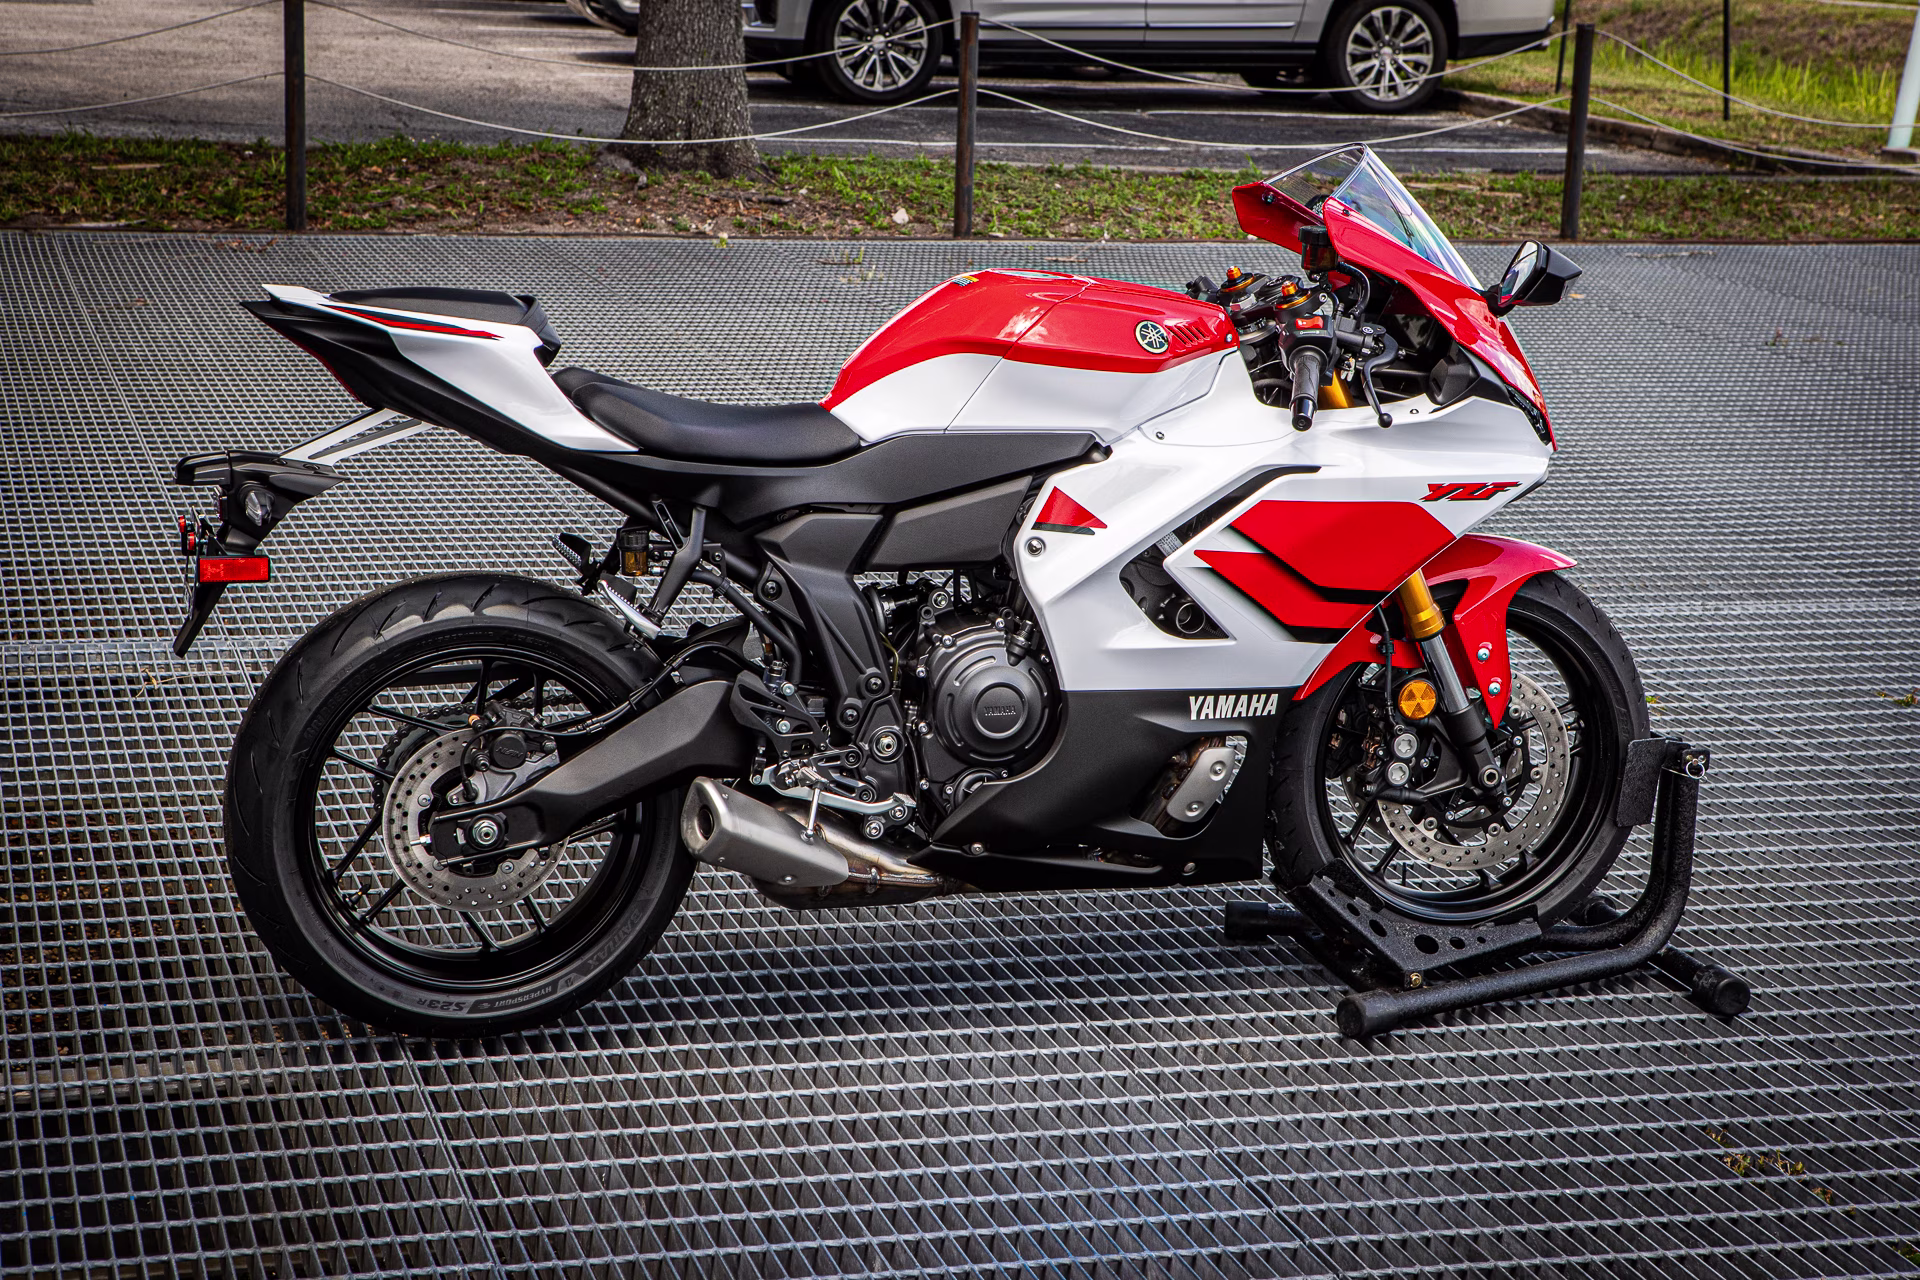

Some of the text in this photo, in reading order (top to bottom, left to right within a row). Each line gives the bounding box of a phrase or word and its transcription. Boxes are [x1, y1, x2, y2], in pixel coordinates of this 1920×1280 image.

[984, 705, 1017, 716] YAMAHA
[1189, 693, 1279, 721] YAMAHA
[586, 908, 644, 970] BATTLAX
[494, 985, 552, 1008] HYPERSPORT
